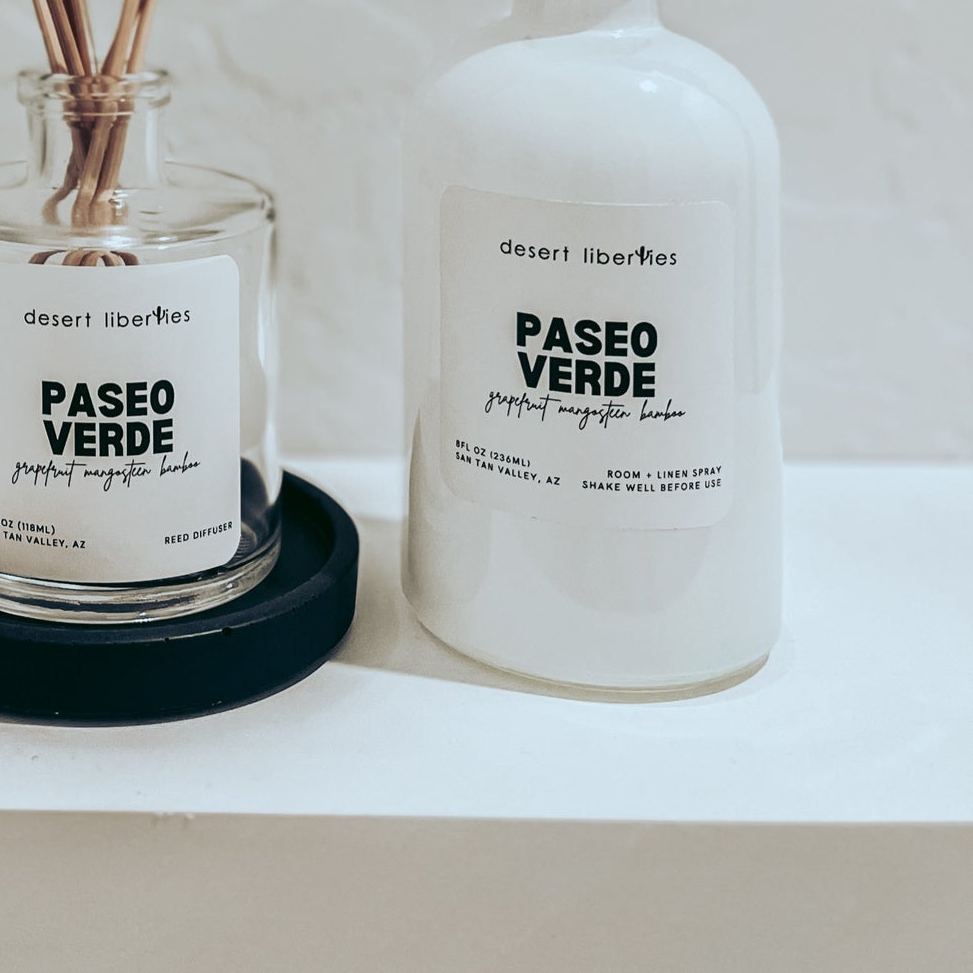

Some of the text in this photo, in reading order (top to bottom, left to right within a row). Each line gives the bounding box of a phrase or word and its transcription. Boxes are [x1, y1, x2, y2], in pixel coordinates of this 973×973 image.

[500, 239, 569, 262] desert
[24, 309, 91, 327] desert
[516, 312, 658, 358] PASEO
[517, 351, 656, 398] VERDE
[41, 379, 175, 418] PASEO
[485, 391, 686, 430] grapefruit mangosteen bamboo
[43, 418, 174, 457] VERDE
[455, 439, 531, 467] 8FL OZ (236ML)
[12, 451, 200, 492] grapefruit mangosteen bamboo
[455, 451, 561, 485] SAN TAN VALLEY, AZ
[607, 470, 641, 479] ROOM
[657, 469, 688, 479] LINEN
[692, 466, 722, 477] SPRAY
[582, 478, 722, 492] SHAKE WELL BEFORE USE
[1, 519, 14, 529] OZ
[17, 521, 55, 535] (118ML)
[3, 531, 22, 542] TAN
[26, 535, 68, 548] VALLEY,
[72, 540, 86, 549] AZ
[165, 521, 232, 545] REED DIFFUSER
